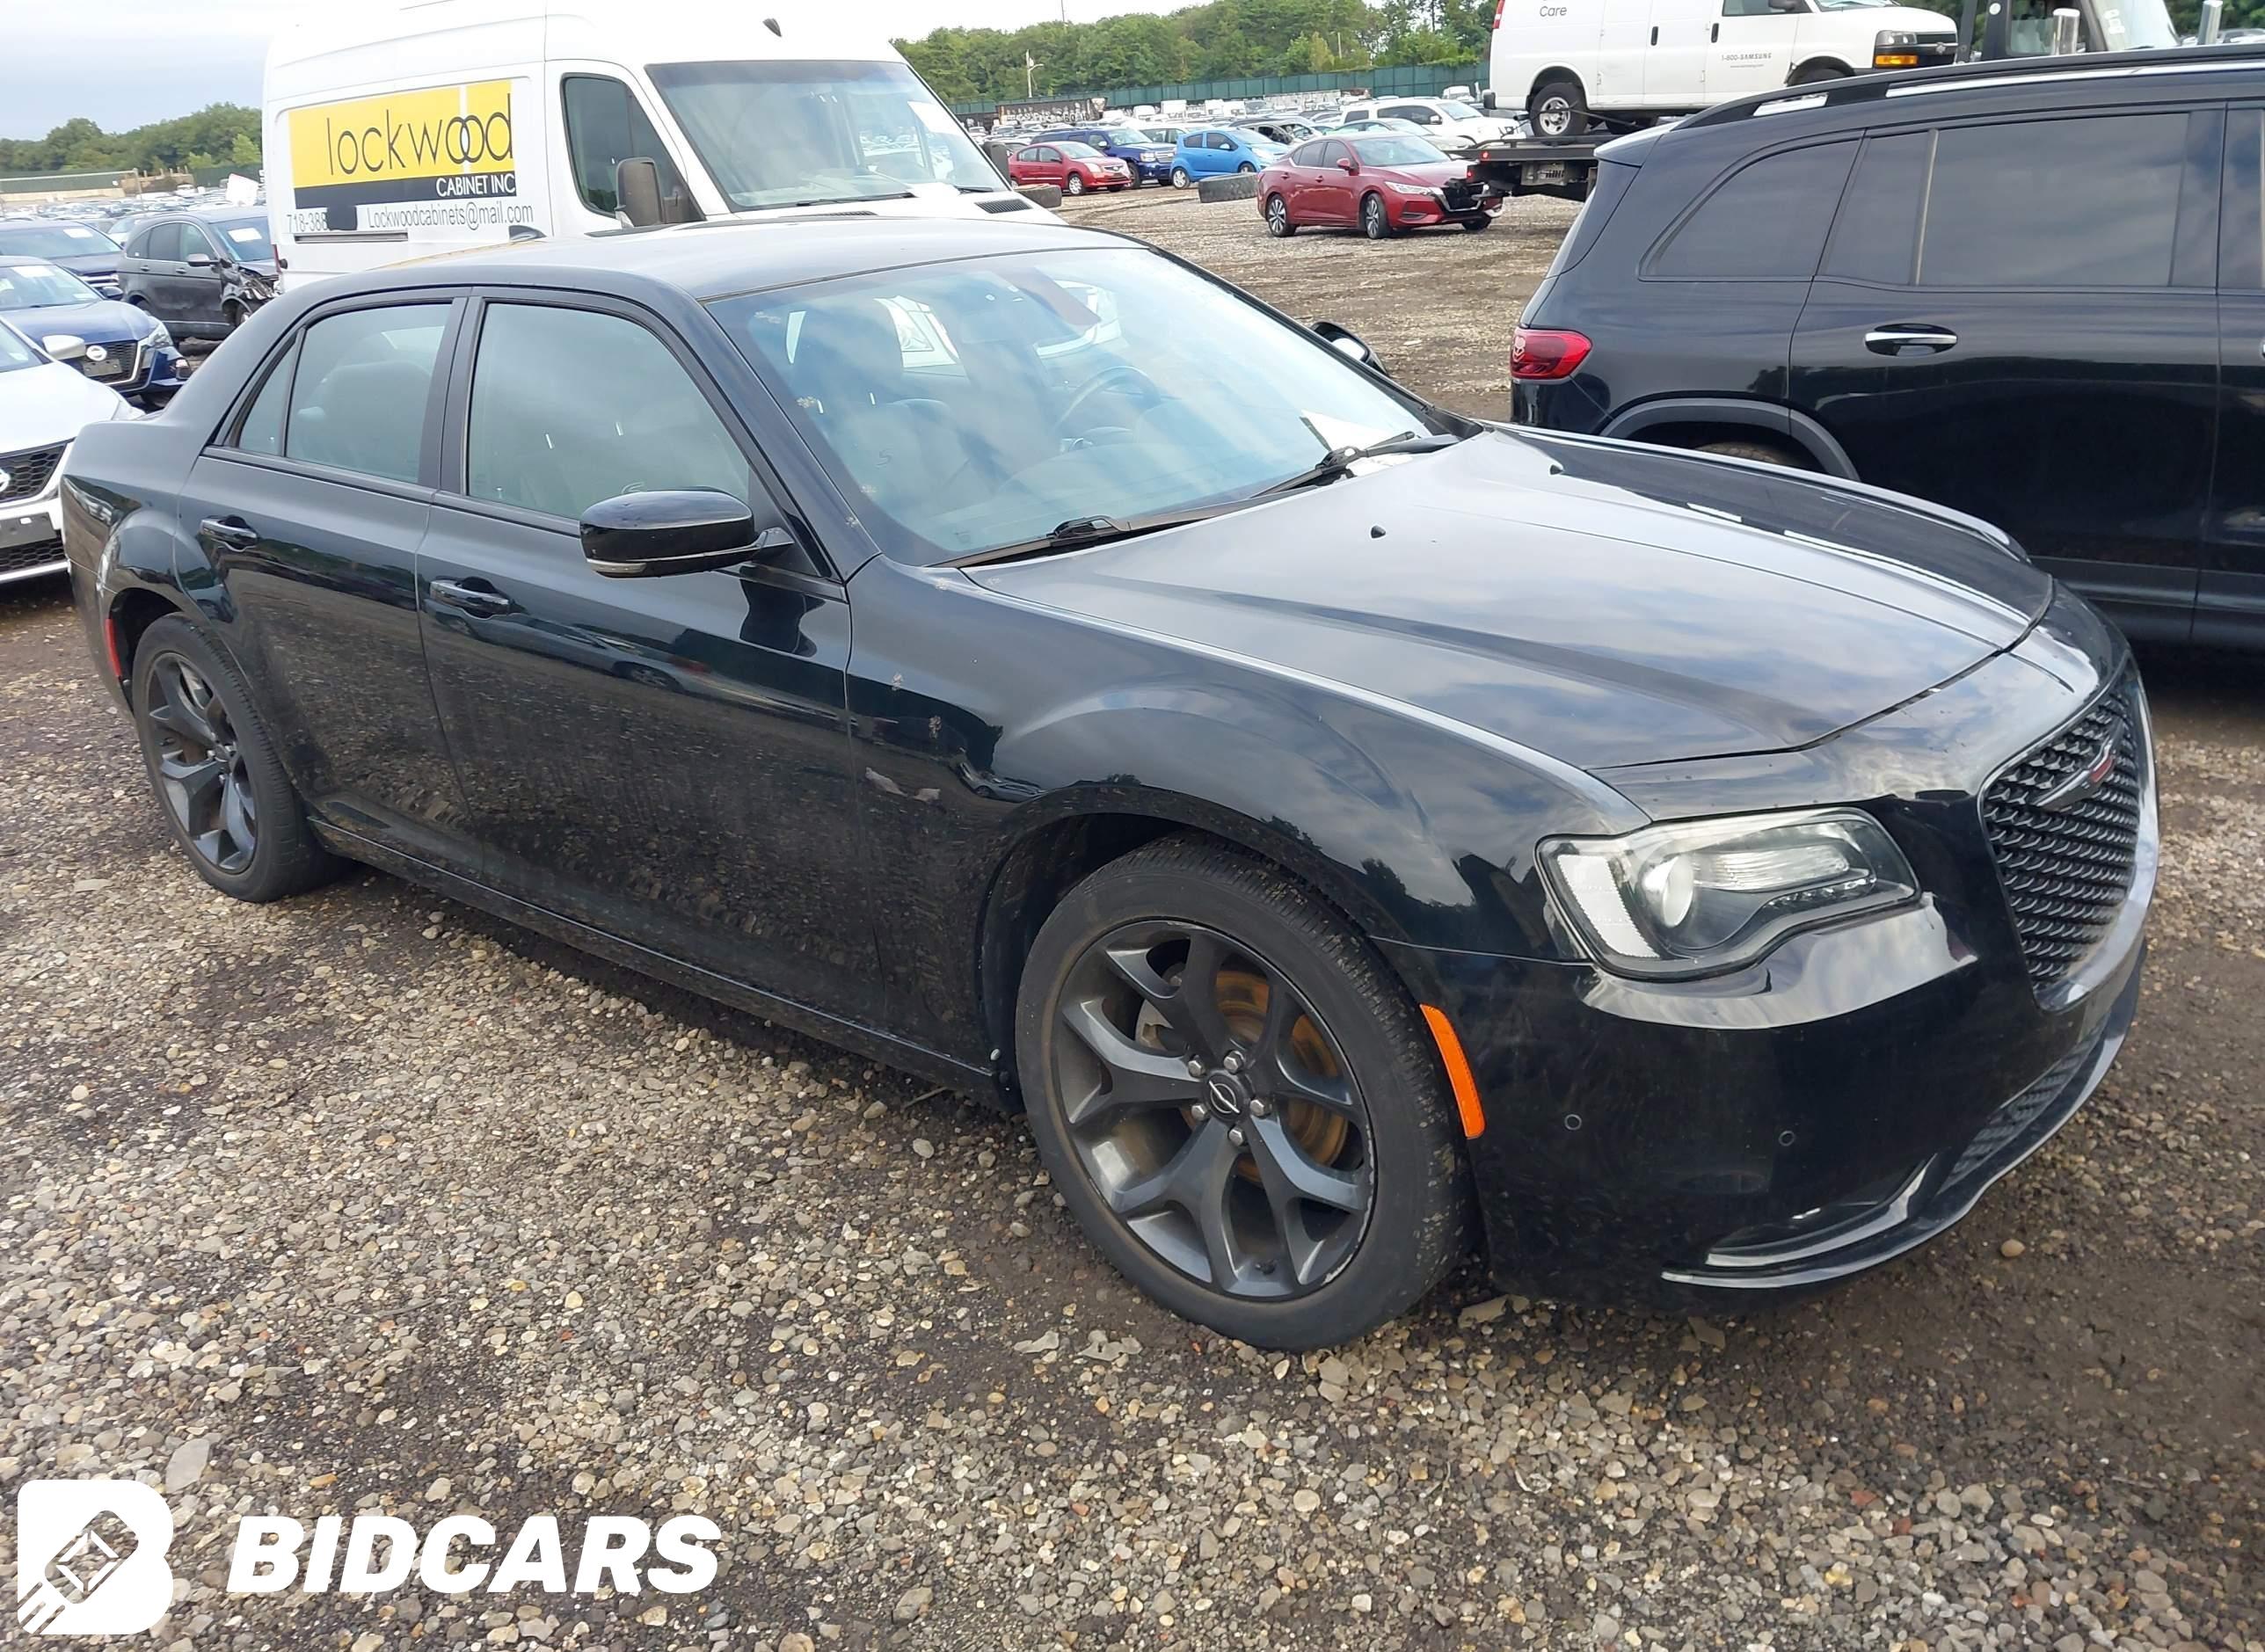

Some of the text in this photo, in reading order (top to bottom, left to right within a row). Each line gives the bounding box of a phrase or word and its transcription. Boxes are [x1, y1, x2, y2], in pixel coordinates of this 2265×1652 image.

[1540, 6, 1567, 17] Care
[326, 92, 513, 176] lockwood
[435, 172, 516, 198] CABINET INC
[367, 200, 534, 230] Lockwoodcabinets@mail.com
